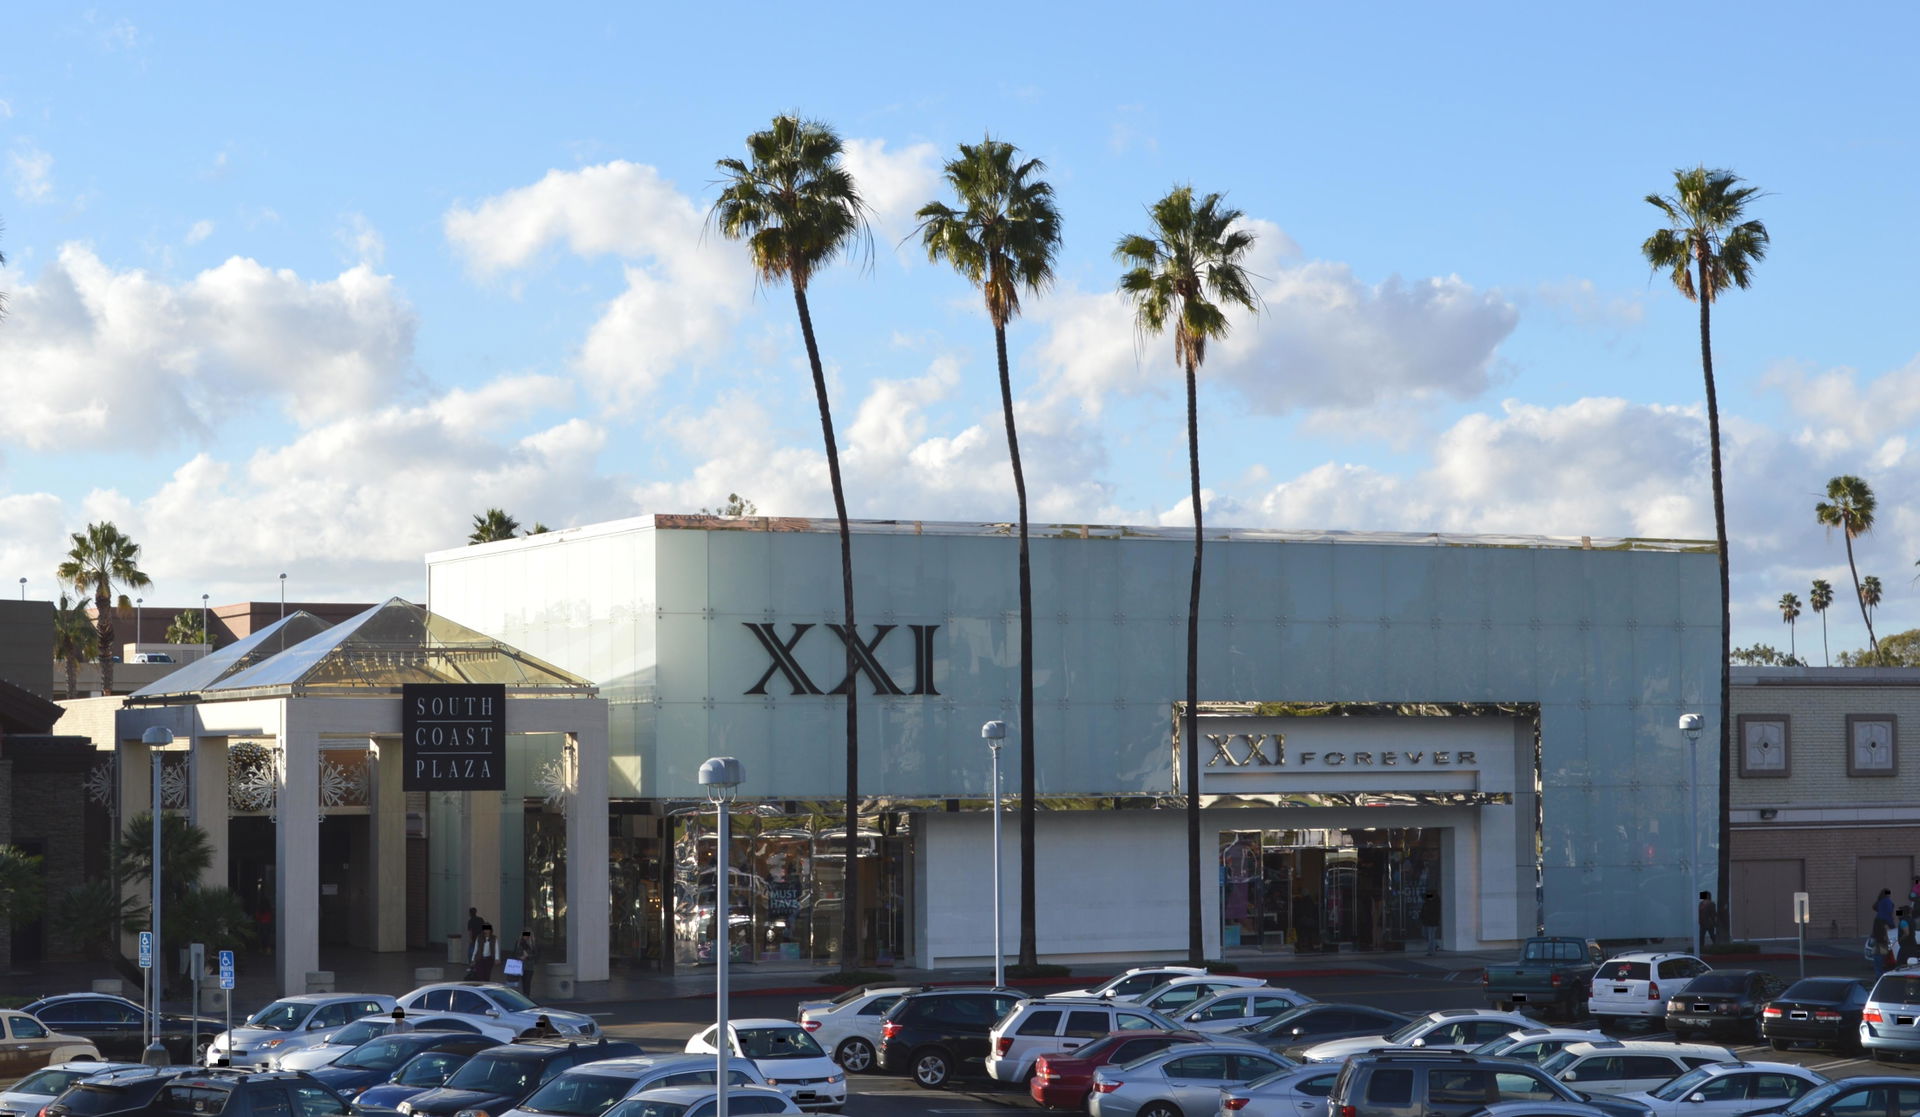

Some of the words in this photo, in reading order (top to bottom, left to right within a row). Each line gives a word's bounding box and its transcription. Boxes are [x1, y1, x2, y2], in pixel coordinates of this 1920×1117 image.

[741, 622, 941, 696] XXI
[416, 697, 493, 716] SOUTH
[415, 727, 493, 746] COAST
[1204, 733, 1287, 768] XXI
[1300, 751, 1477, 766] FOREVER
[416, 759, 491, 779] PLAZA
[770, 890, 798, 899] MUST
